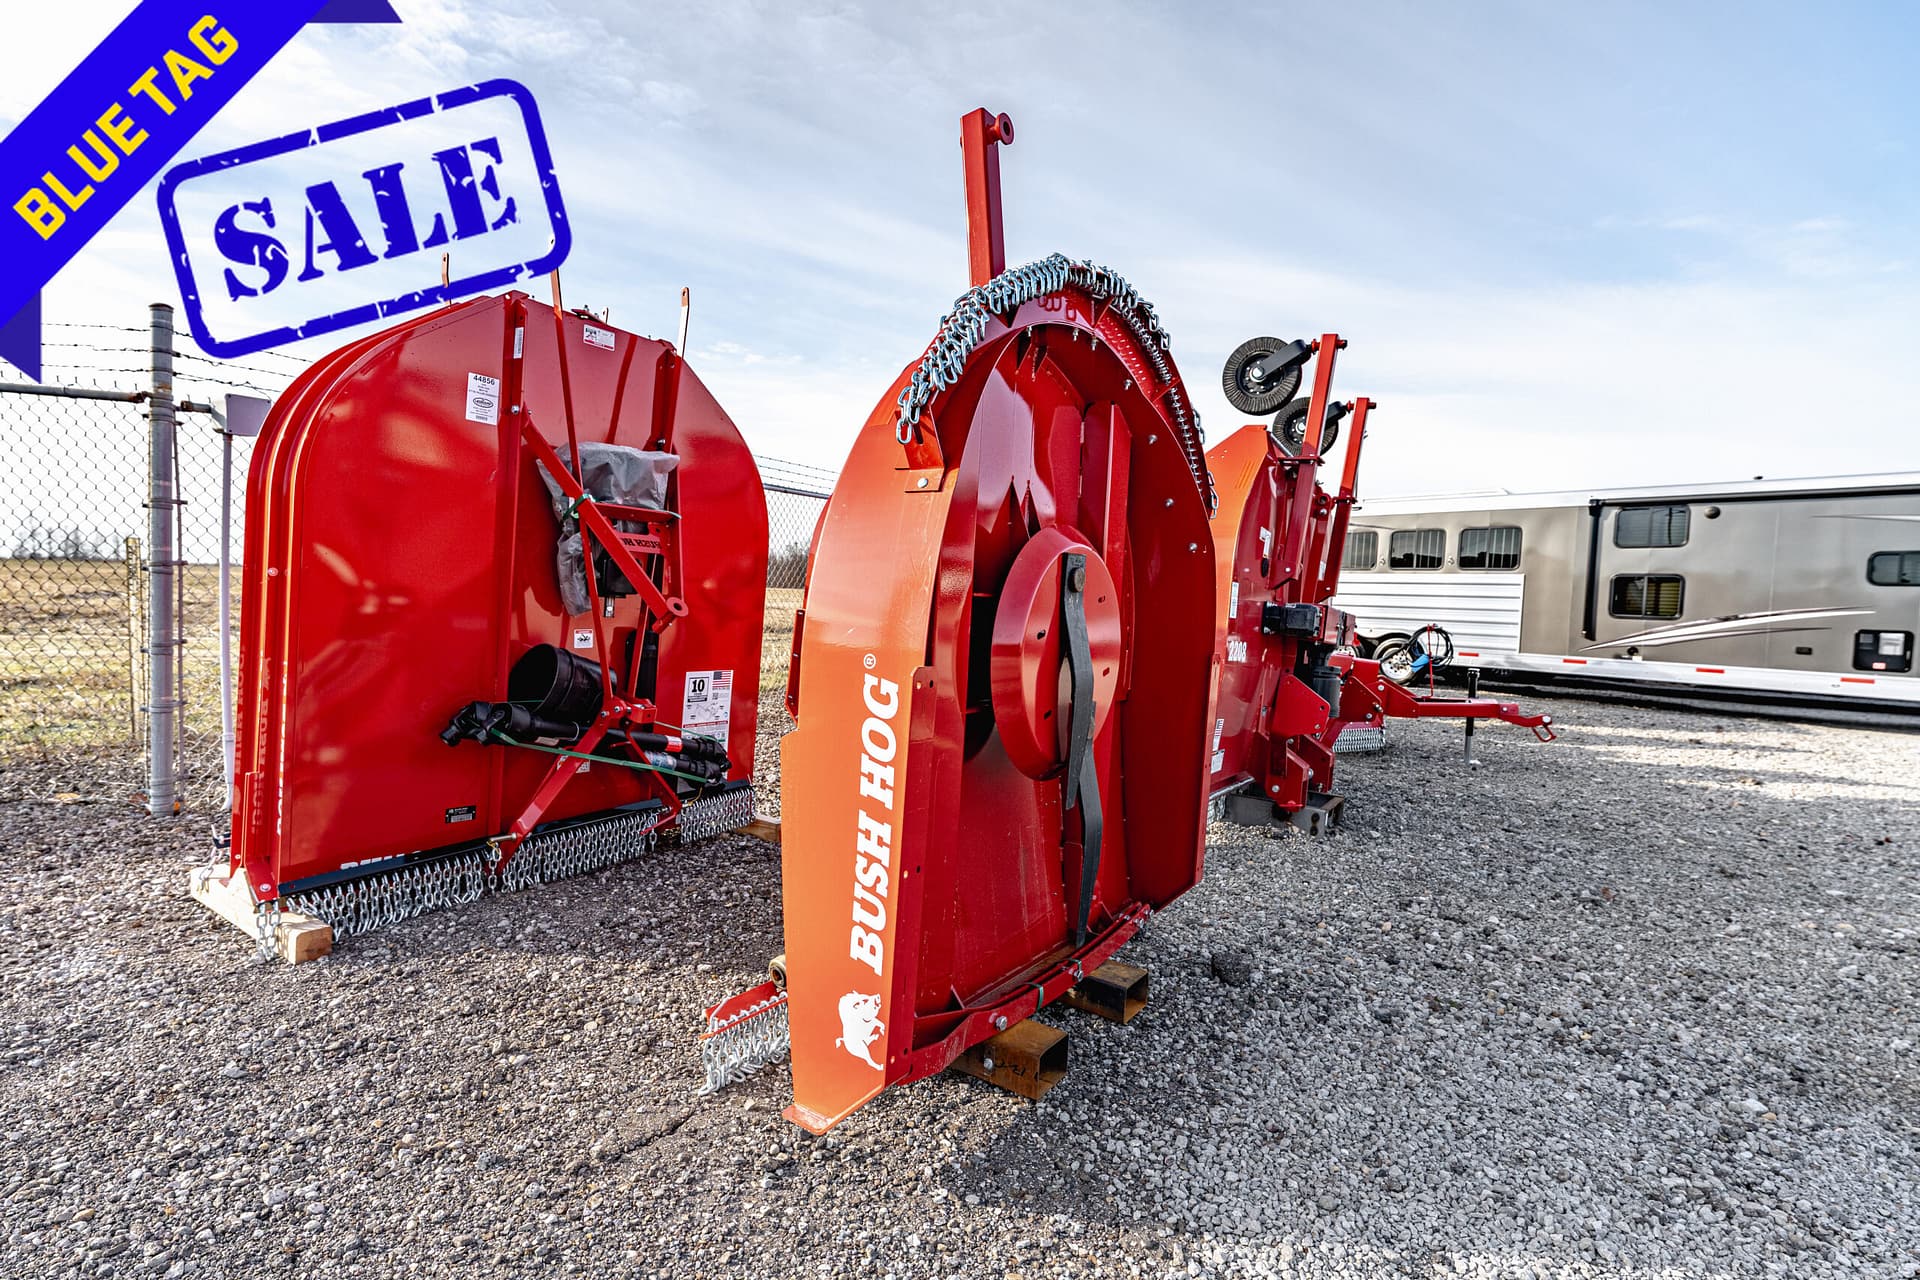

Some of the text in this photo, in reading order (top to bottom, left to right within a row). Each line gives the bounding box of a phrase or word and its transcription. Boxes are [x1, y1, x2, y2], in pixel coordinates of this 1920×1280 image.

[473, 375, 496, 386] 44856
[691, 679, 705, 693] 10
[849, 809, 892, 977] BUSH
